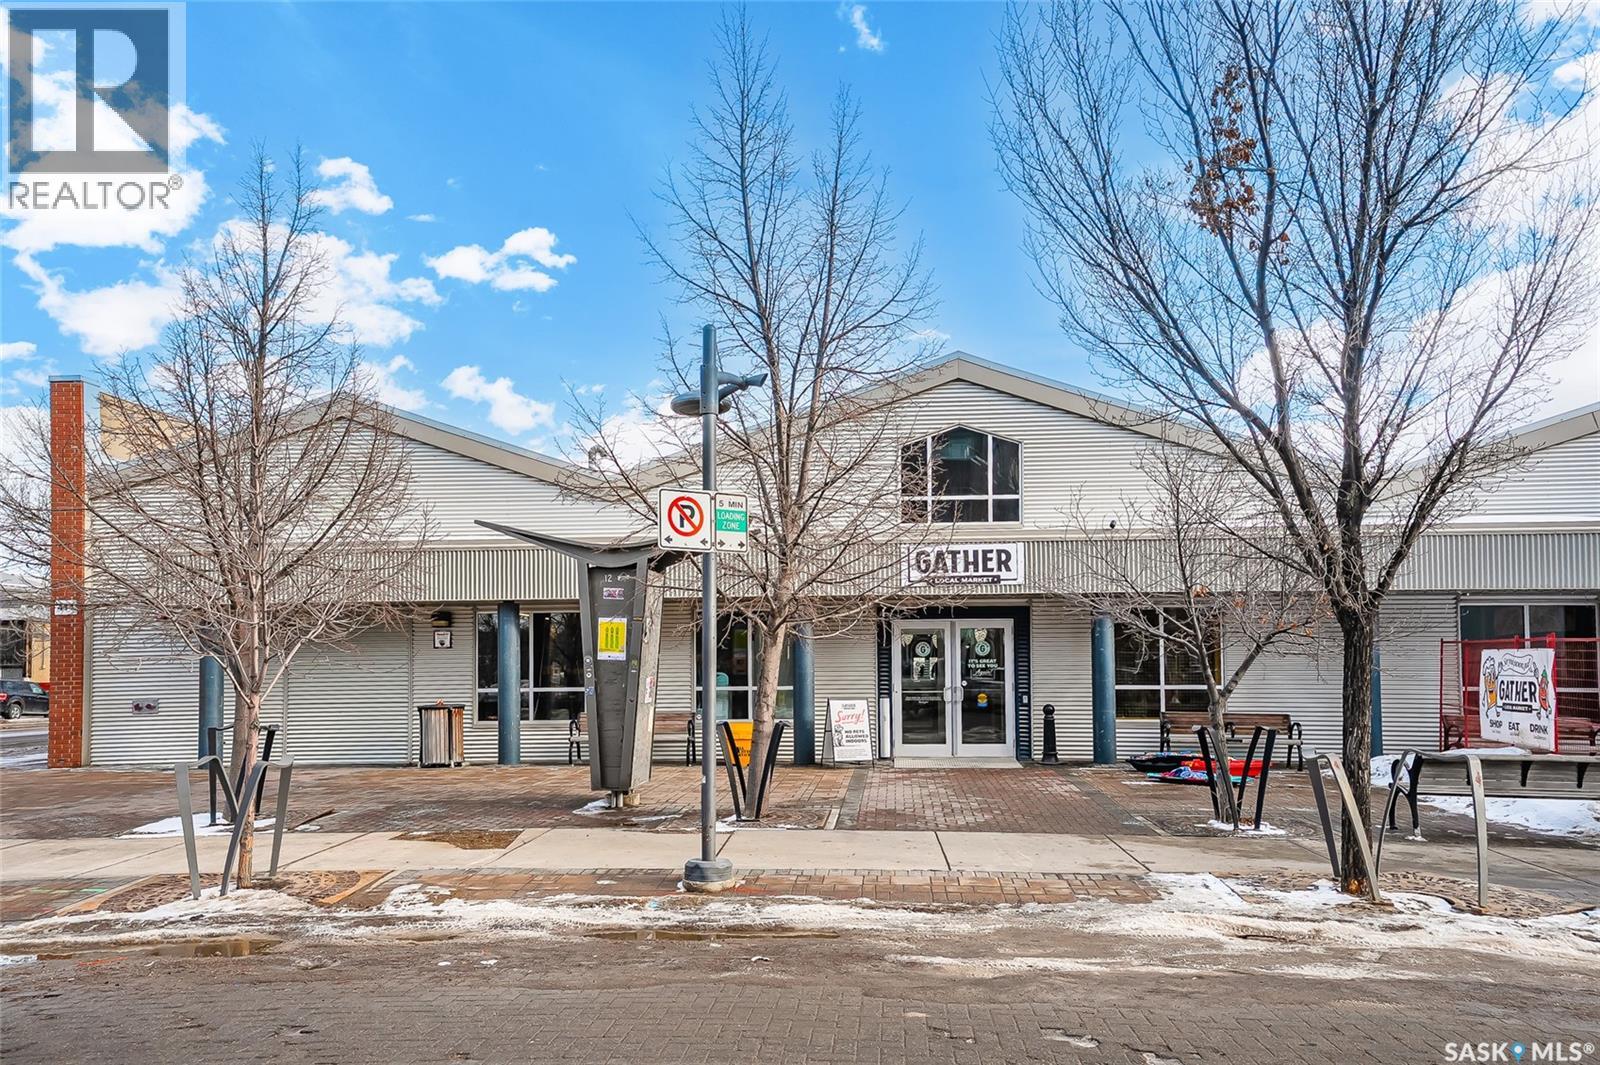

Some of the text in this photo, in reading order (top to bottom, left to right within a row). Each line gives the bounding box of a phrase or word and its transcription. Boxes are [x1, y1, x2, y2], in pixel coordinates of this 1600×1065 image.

[718, 500, 744, 509] 5 MIN
[717, 512, 745, 521] LOADING
[722, 520, 740, 530] ZONE
[915, 548, 1012, 574] GATHER
[604, 574, 613, 583] 12
[1499, 680, 1538, 703] GATHER
[835, 709, 866, 724] Sorry!
[1489, 719, 1503, 729] SHOP
[1508, 721, 1520, 731] EAT
[1529, 723, 1549, 735] DRINK
